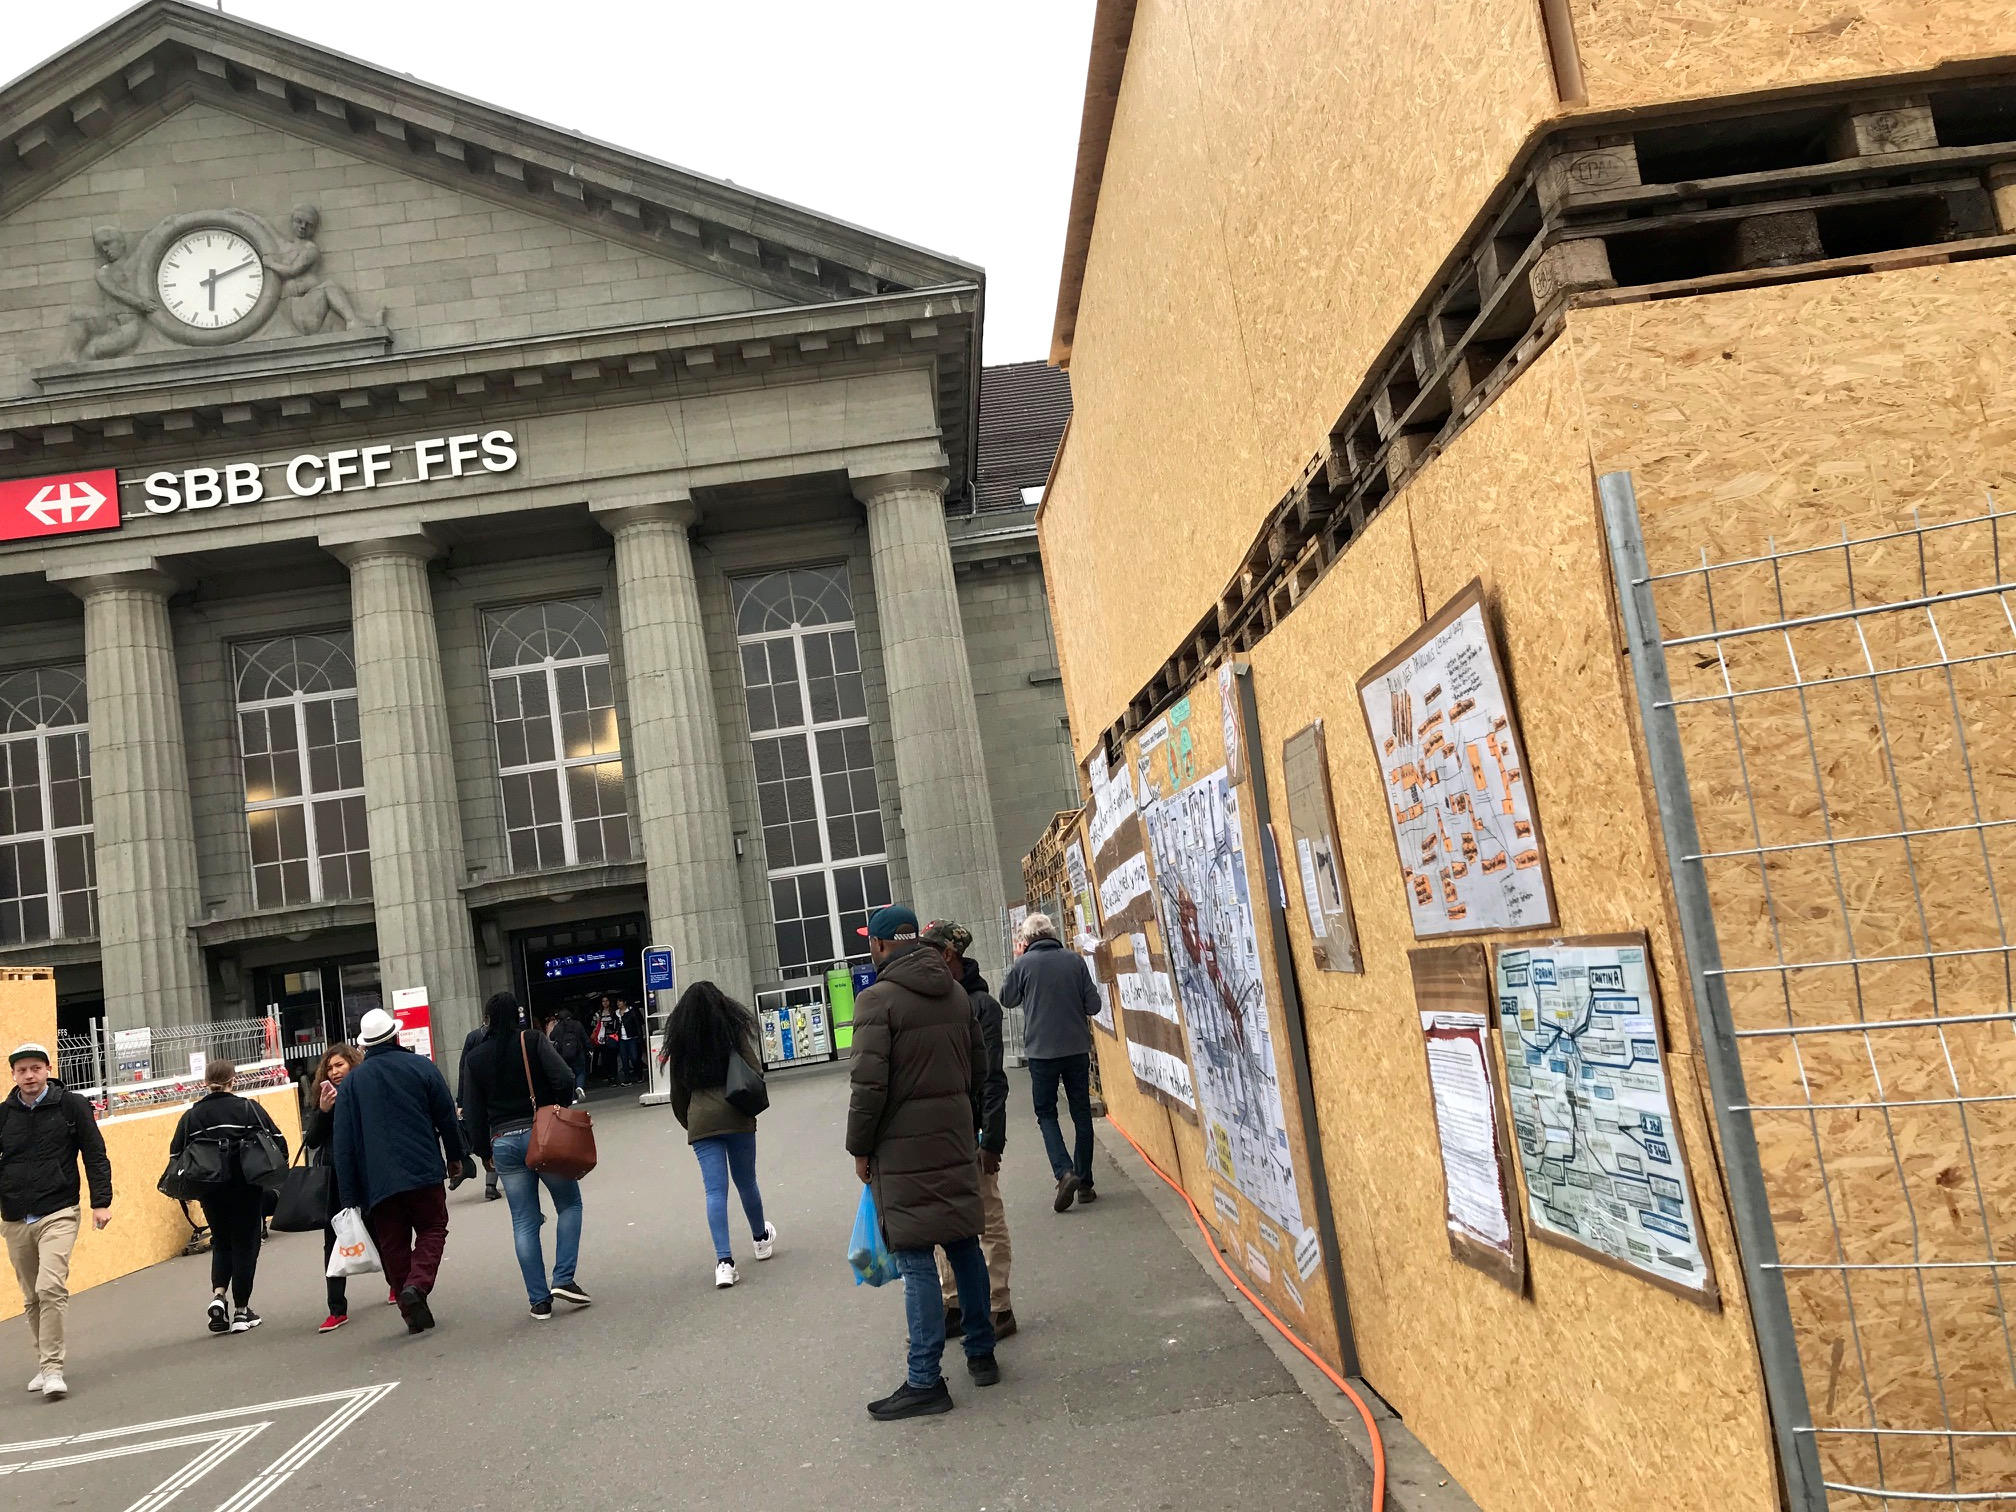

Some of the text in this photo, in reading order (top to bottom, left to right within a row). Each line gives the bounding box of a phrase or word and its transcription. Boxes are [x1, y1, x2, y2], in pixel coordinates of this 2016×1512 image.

[144, 430, 519, 515] SBB CFF FFS
[1591, 971, 1620, 986] CANTINA
